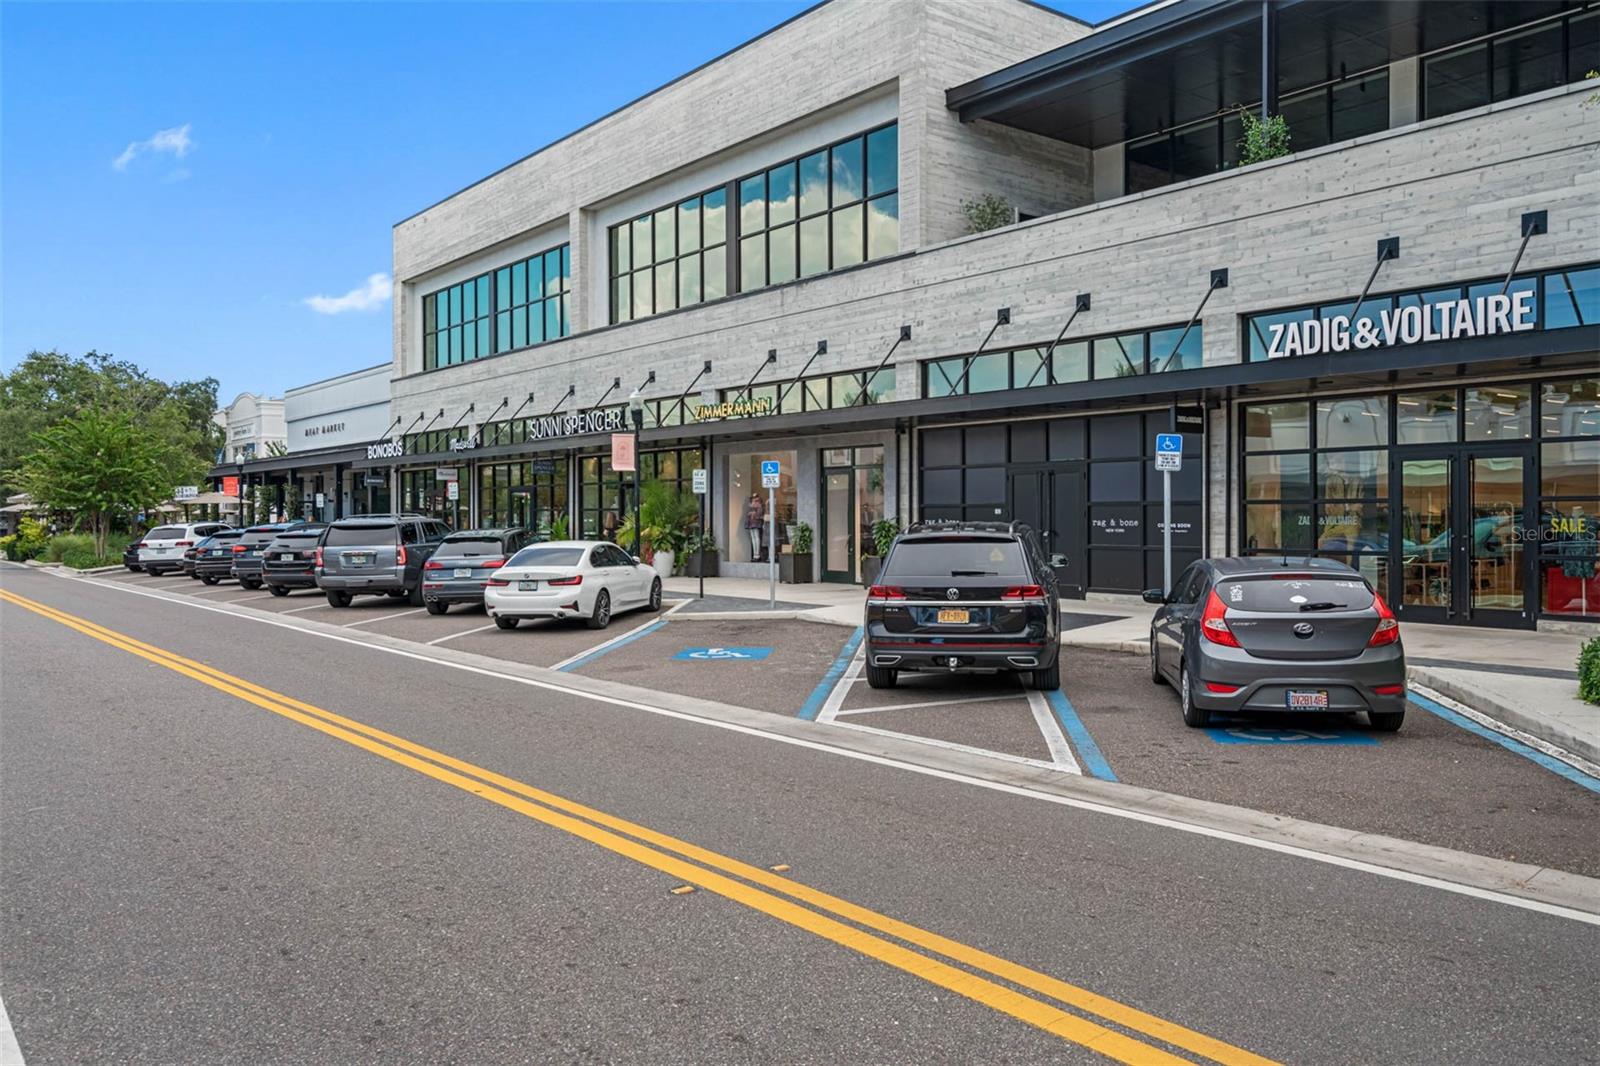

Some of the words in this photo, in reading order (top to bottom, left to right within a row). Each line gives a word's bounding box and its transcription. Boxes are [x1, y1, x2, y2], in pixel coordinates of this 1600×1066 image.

[1267, 290, 1535, 359] ZADIG&VOLTAIRE
[694, 397, 772, 420] ZIMMERMANN
[322, 422, 345, 434] MARKET
[530, 416, 562, 439] SUNNI
[564, 409, 621, 435] SPENCER
[367, 442, 403, 459] BONOBOS
[1119, 519, 1139, 527] bone
[1551, 518, 1586, 533] SALE
